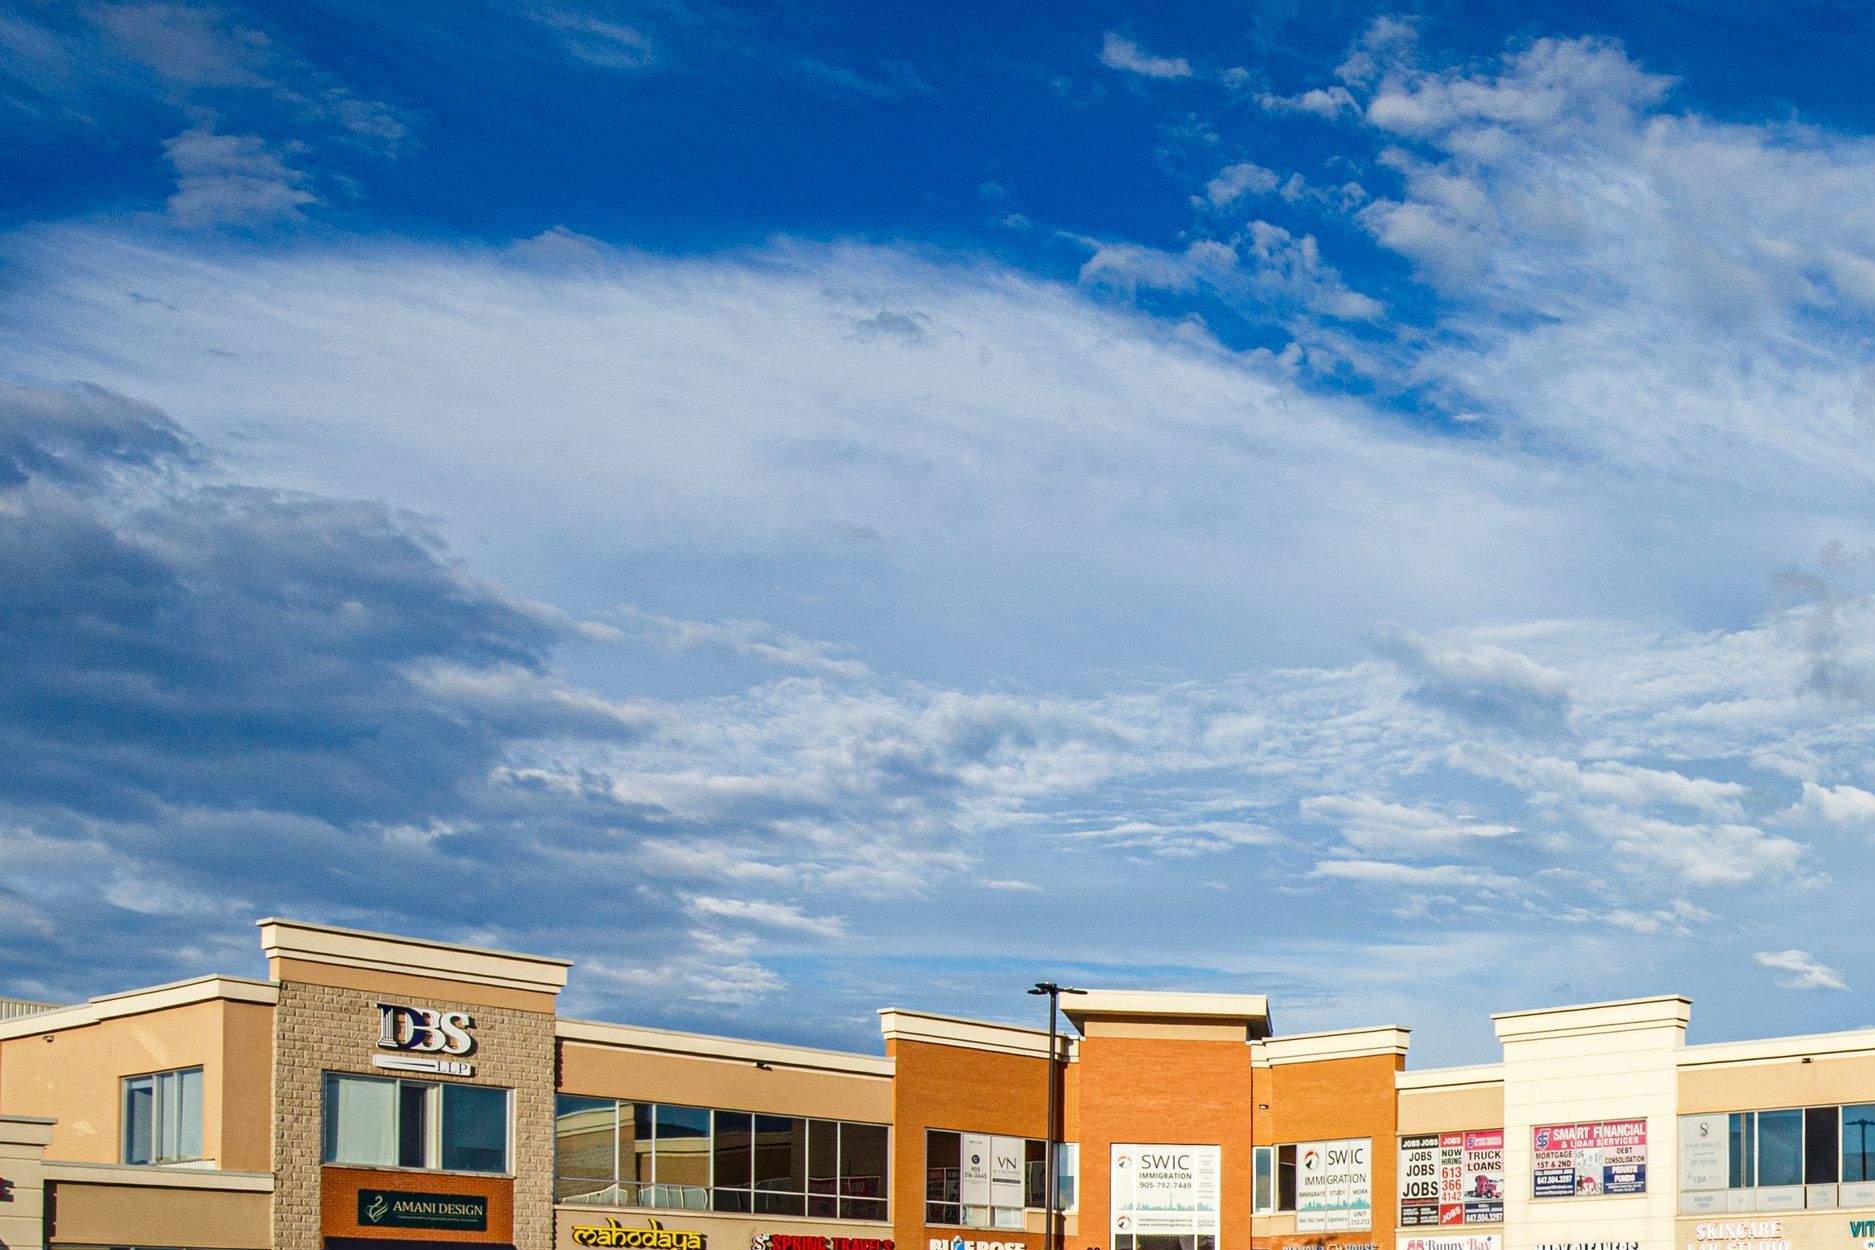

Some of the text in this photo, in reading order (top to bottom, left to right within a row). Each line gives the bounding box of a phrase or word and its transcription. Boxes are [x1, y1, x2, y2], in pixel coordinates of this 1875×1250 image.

[375, 1003, 478, 1057] DBS
[437, 1061, 468, 1074] LLP
[1553, 1123, 1646, 1141] SMART FINANCIAL
[1403, 1138, 1438, 1148] JOBS JOBS
[1443, 1136, 1461, 1145] JOBS
[1571, 1140, 1595, 1148] LOAN
[1597, 1136, 1640, 1147] SERVICES
[1328, 1148, 1364, 1166] SWIC
[1409, 1151, 1432, 1162] JOBS
[1441, 1149, 1462, 1157] NOW
[1468, 1150, 1501, 1160] TRUCK
[1536, 1151, 1573, 1159] MORTGAGE
[997, 1156, 1017, 1170] VN
[1141, 1155, 1190, 1170] SWIC
[1441, 1157, 1462, 1165] HIRING
[1537, 1161, 1549, 1169] 1ST
[1558, 1160, 1571, 1168] 2ND
[1605, 1156, 1645, 1164] CONSOLIDATION
[1406, 1164, 1435, 1177] JOBS
[1468, 1161, 1501, 1171] LOANS
[1442, 1167, 1462, 1178] 613
[1305, 1174, 1366, 1186] IMMIGRATION
[1442, 1180, 1462, 1191] 366
[1403, 1181, 1439, 1197] JOBS
[1442, 1191, 1462, 1201] 4142
[393, 1201, 483, 1216] AMANI DESIGN
[1442, 1206, 1462, 1223] JOBS
[1696, 1221, 1781, 1241] SKINCARE
